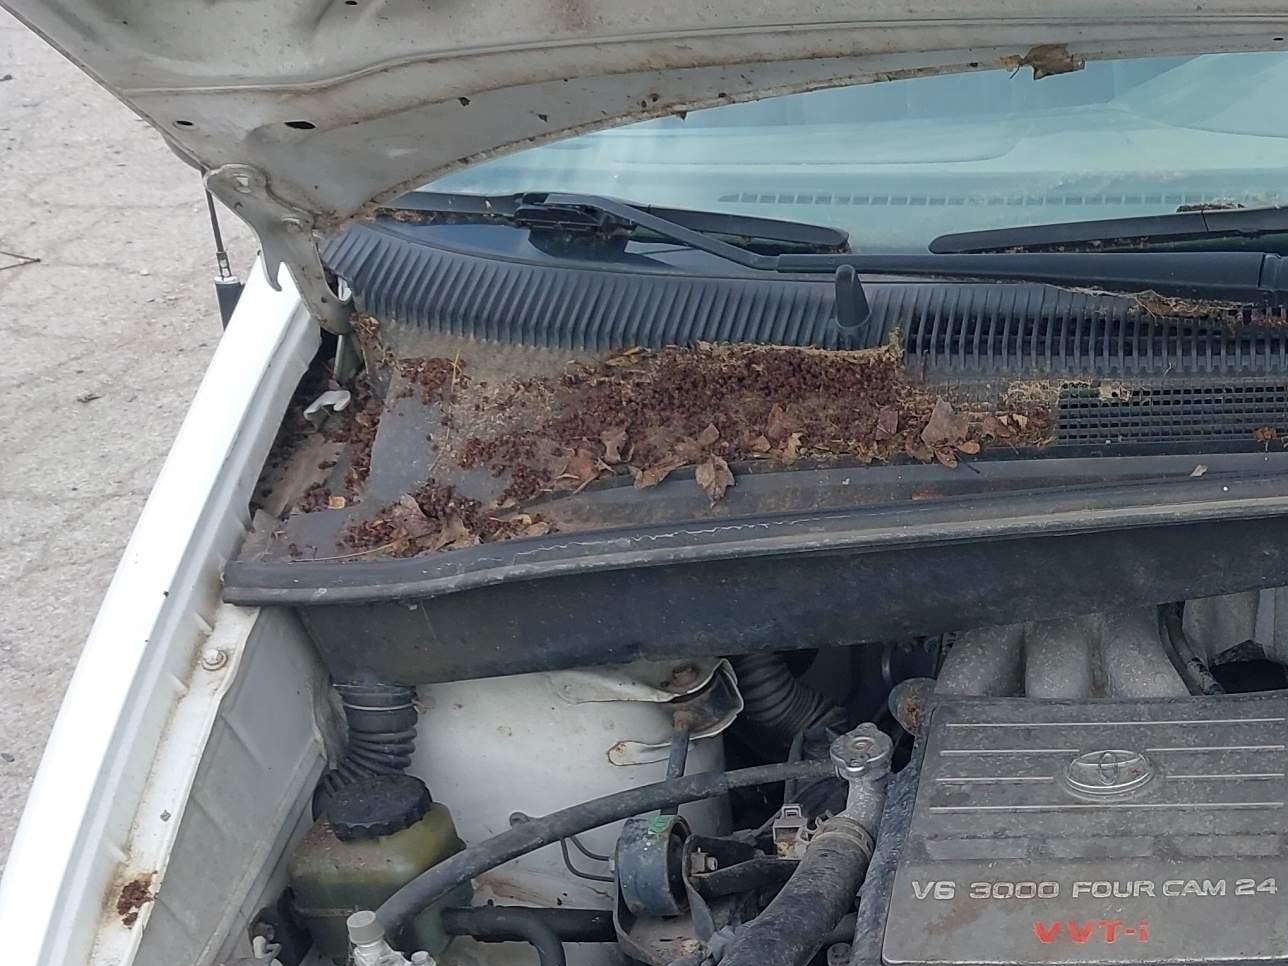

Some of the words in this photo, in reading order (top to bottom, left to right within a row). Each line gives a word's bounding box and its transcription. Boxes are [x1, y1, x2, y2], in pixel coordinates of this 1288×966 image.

[911, 880, 956, 900] V6
[968, 880, 1060, 900] 3000
[1071, 879, 1156, 899] FOUR
[1162, 878, 1227, 897] CAM
[1234, 877, 1278, 896] 24
[1033, 918, 1151, 944] VVT-i
